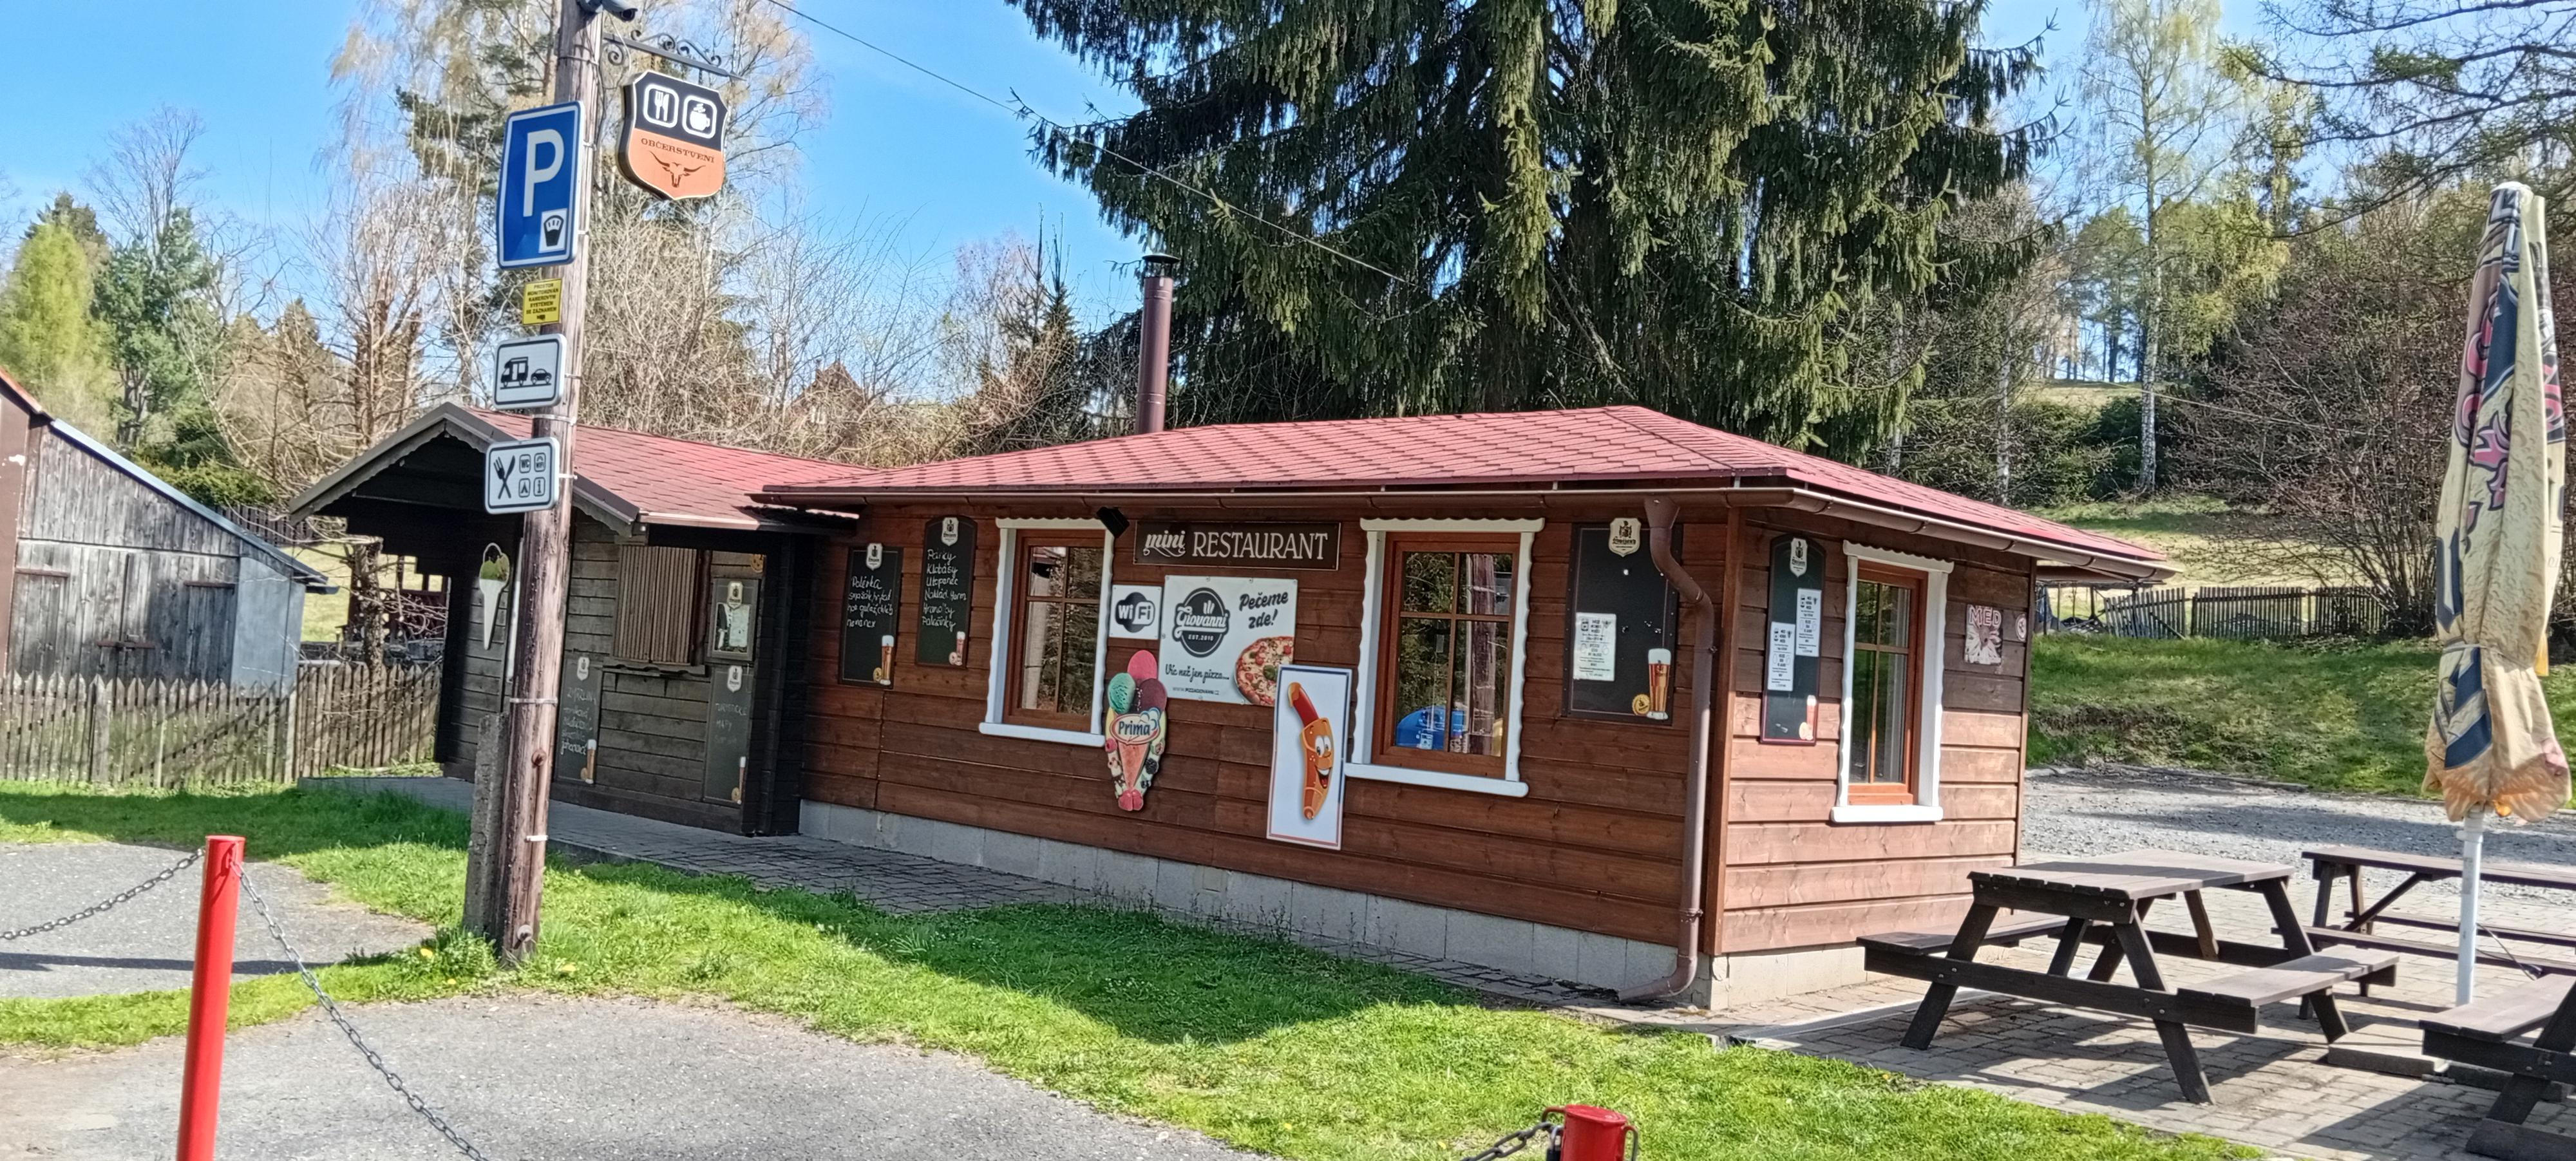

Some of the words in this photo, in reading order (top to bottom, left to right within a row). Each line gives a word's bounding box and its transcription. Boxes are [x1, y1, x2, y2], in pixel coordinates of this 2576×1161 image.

[523, 129, 565, 217] P
[1143, 530, 1186, 557] mini
[1192, 532, 1328, 560] RESTAURANT
[1239, 592, 1289, 611] Pečeme
[1175, 606, 1227, 632] Giovanni
[1249, 609, 1278, 629] zde!
[1968, 607, 2002, 628] MED
[1118, 721, 1151, 735] Prima
